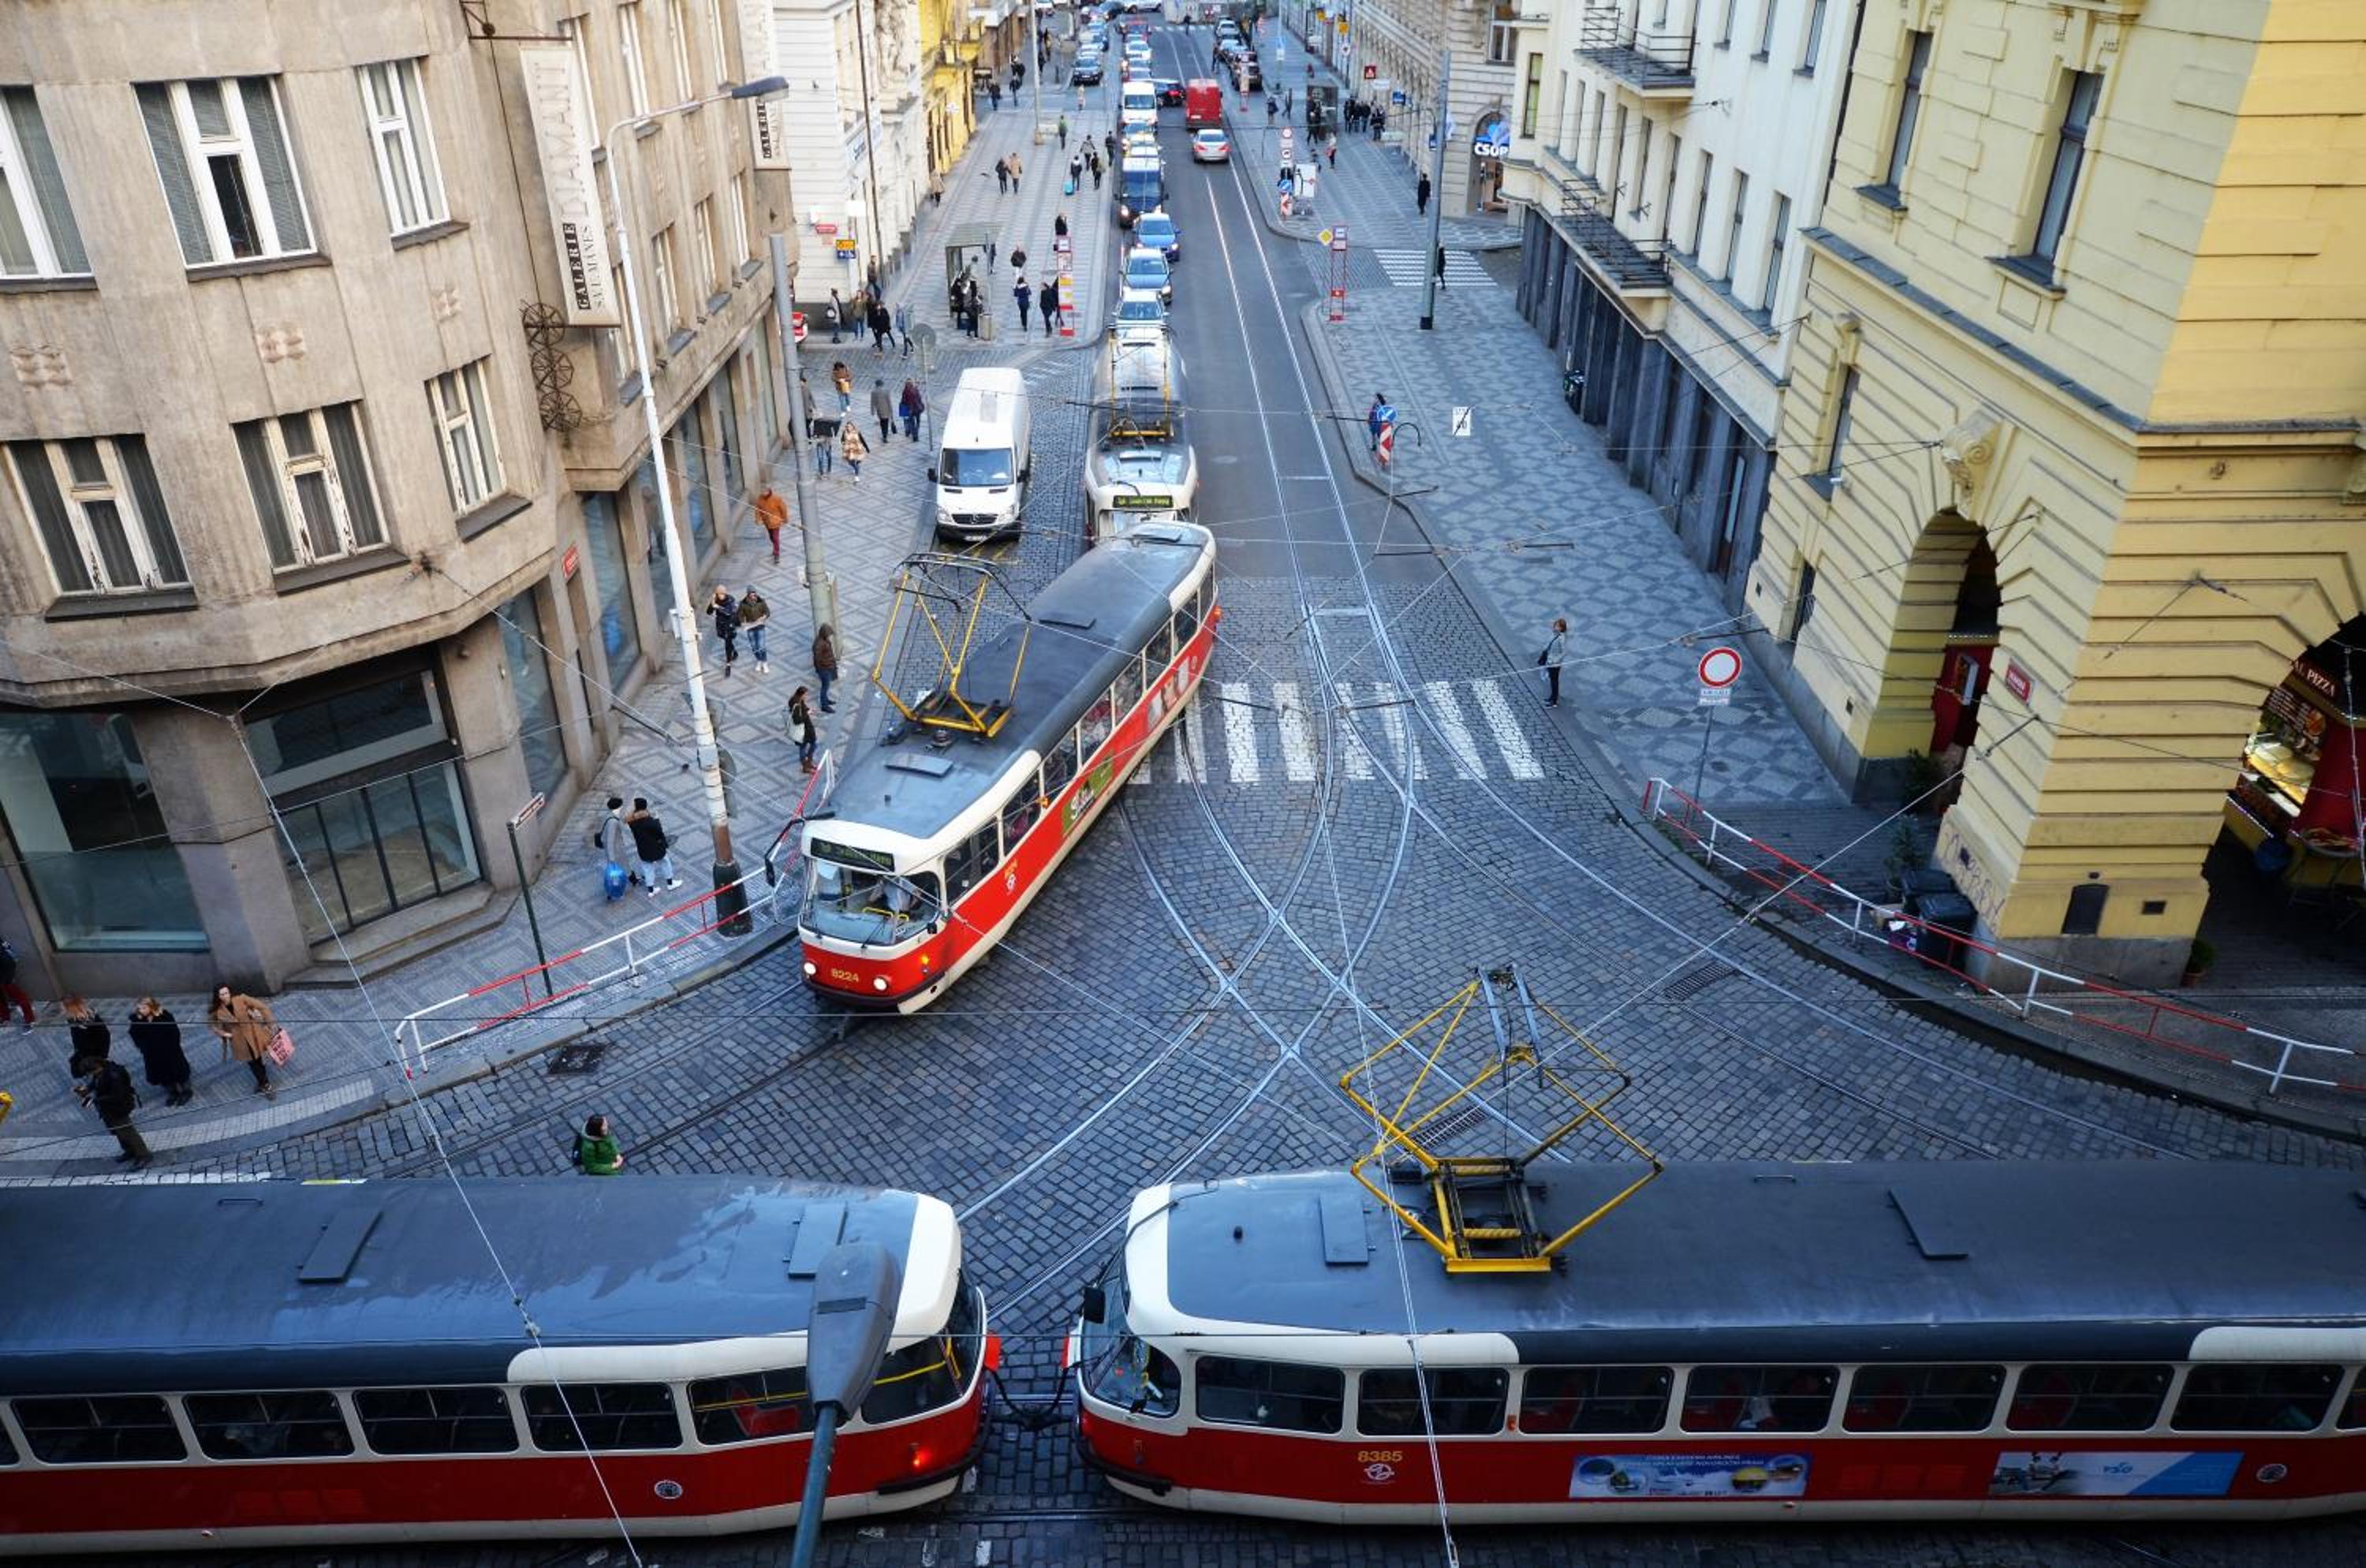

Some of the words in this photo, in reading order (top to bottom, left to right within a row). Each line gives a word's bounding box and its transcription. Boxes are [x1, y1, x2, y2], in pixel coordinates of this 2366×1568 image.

[563, 223, 592, 308] GALERIE
[2307, 669, 2335, 696] PIZZA
[1357, 1450, 1402, 1462] 8385
